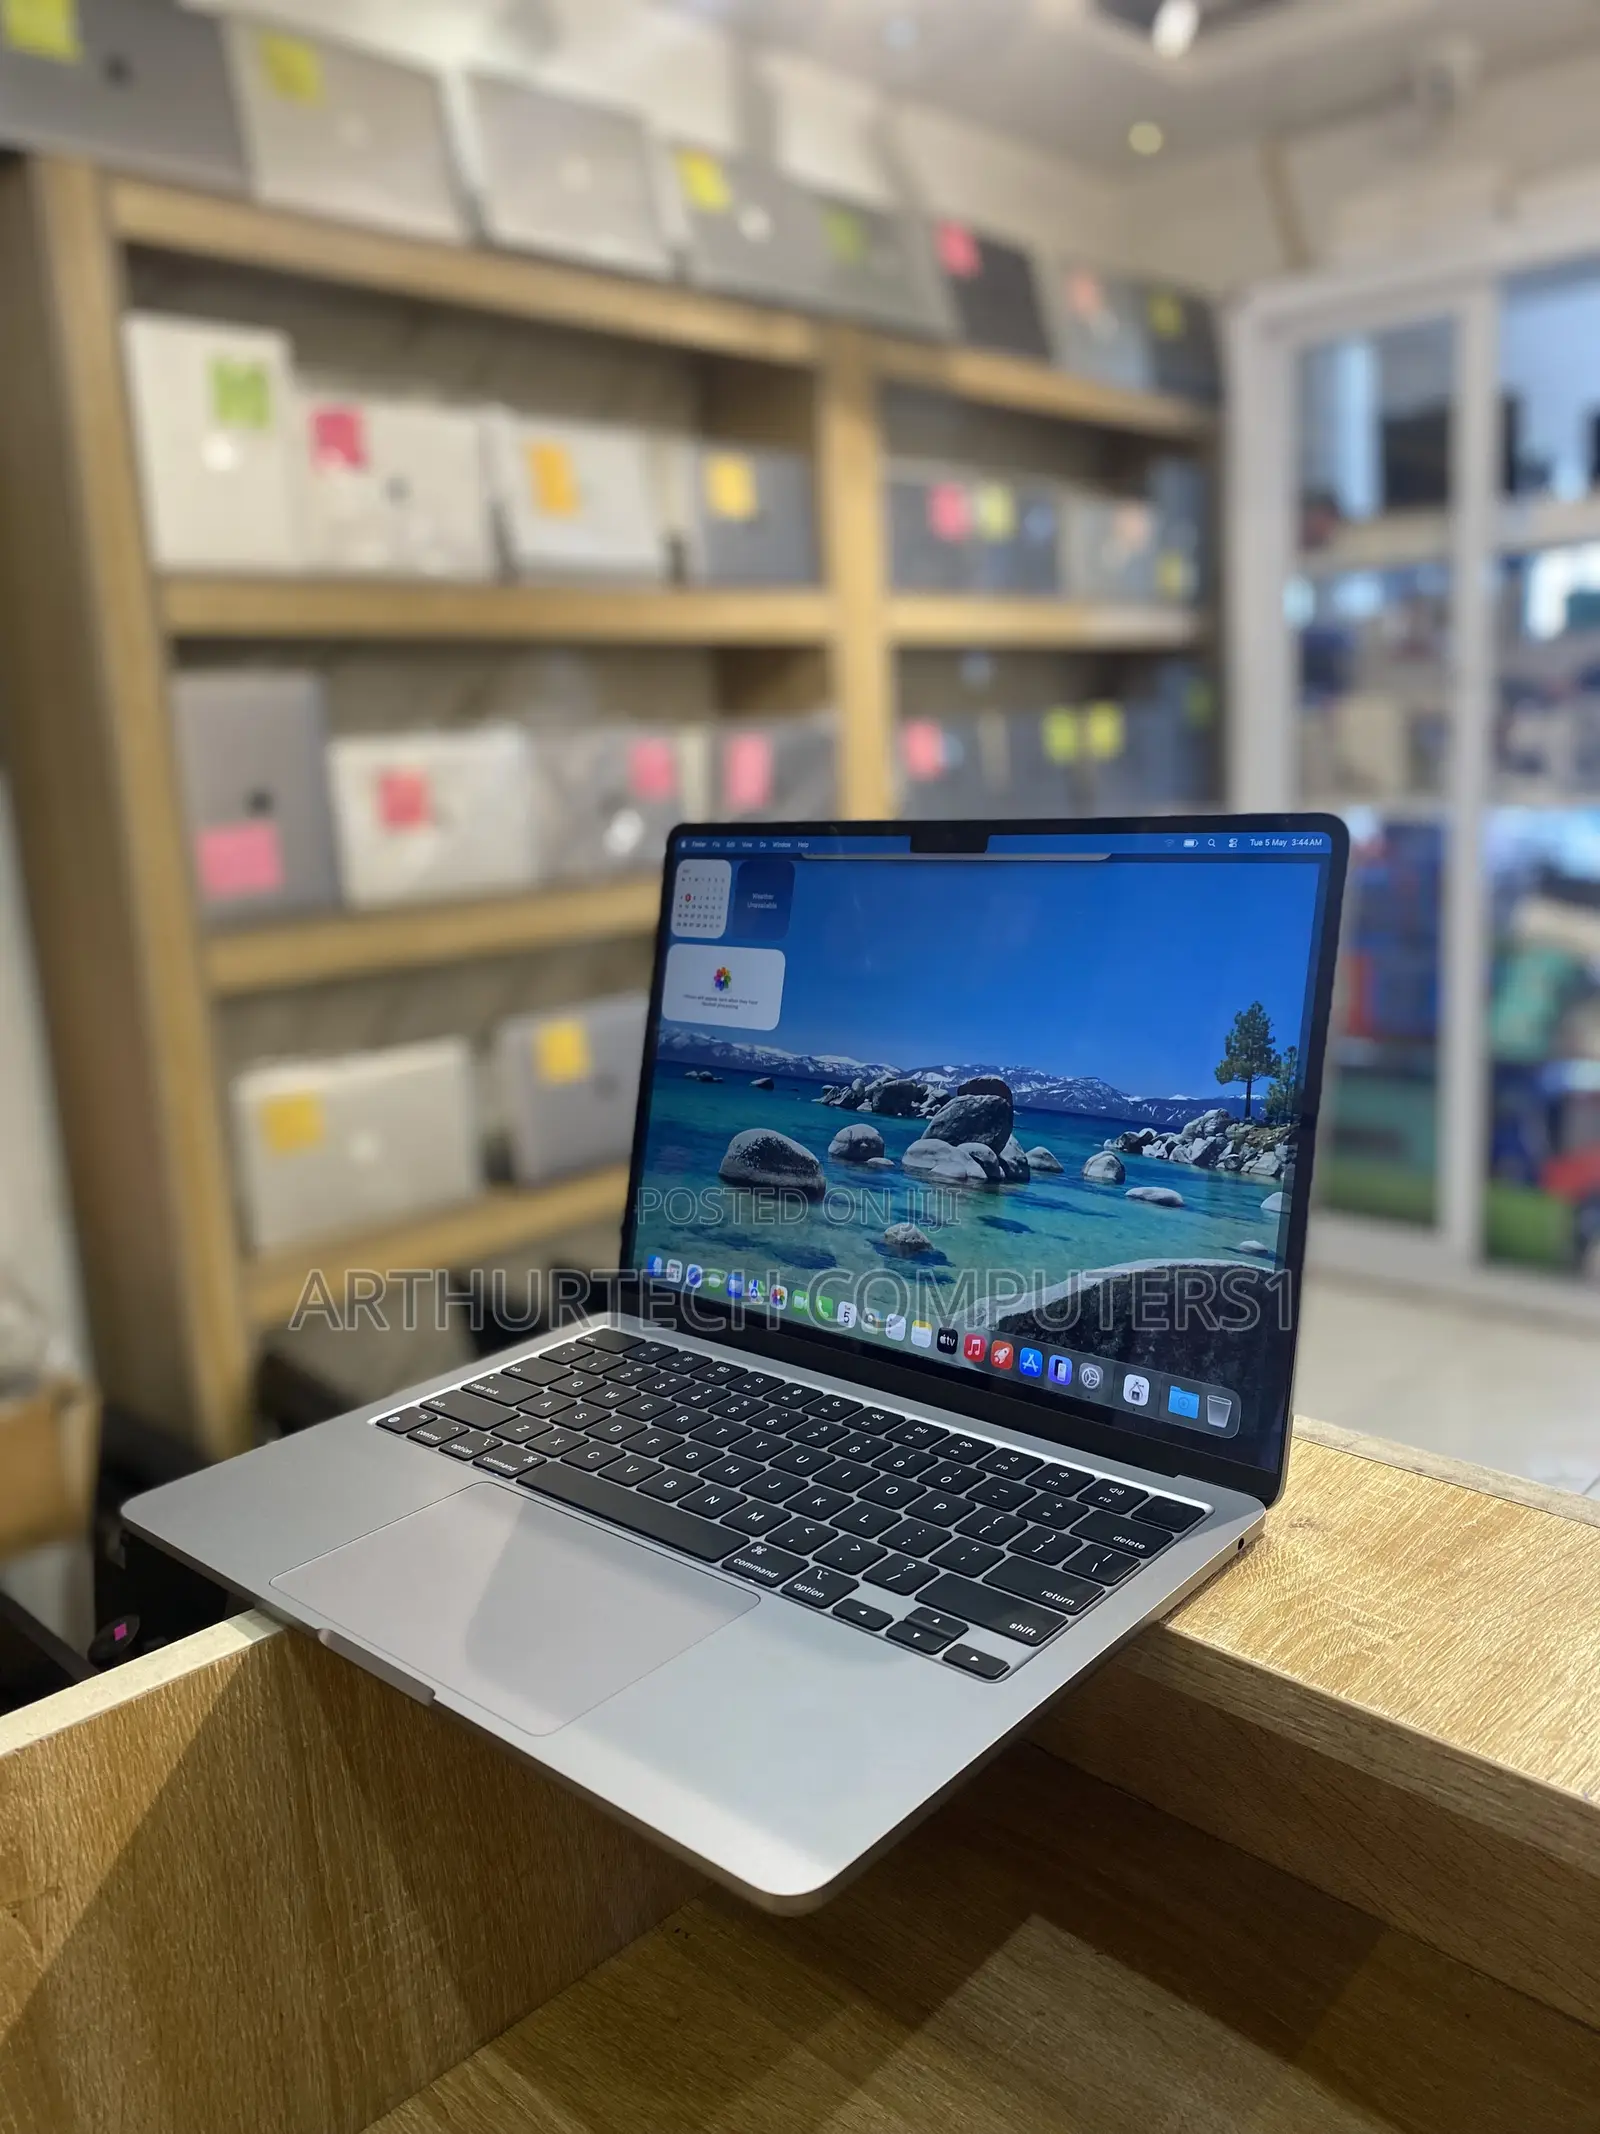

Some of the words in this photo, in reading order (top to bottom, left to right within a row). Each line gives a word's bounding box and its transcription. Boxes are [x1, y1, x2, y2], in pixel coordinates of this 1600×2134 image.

[1250, 838, 1263, 846] Tue
[1265, 838, 1270, 846] 5
[1272, 838, 1288, 848] May
[843, 1311, 850, 1324] 5
[571, 1380, 584, 1388] Q
[604, 1391, 620, 1399] W
[429, 1400, 446, 1408] shift
[640, 1403, 653, 1411] E
[574, 1412, 587, 1420] S
[676, 1415, 689, 1423] R
[515, 1424, 530, 1433] Z
[609, 1424, 623, 1432] D
[716, 1427, 728, 1435] T
[416, 1429, 442, 1441] control
[550, 1437, 565, 1446] X
[756, 1441, 768, 1449] Y
[450, 1443, 473, 1455] option
[587, 1451, 600, 1459] C
[685, 1451, 699, 1459] G
[796, 1455, 810, 1464] U
[483, 1456, 518, 1472] command
[893, 1460, 905, 1468] 9
[626, 1465, 639, 1473] V
[724, 1465, 740, 1474] H
[663, 1480, 677, 1489] B
[704, 1495, 721, 1505] N
[811, 1497, 827, 1506] K
[933, 1502, 947, 1510] P
[747, 1511, 765, 1522] M
[859, 1514, 869, 1523] L
[1113, 1535, 1145, 1549] delete
[733, 1557, 778, 1579] command
[793, 1583, 825, 1599] option
[1041, 1589, 1075, 1606] return
[1009, 1622, 1037, 1637] shift
